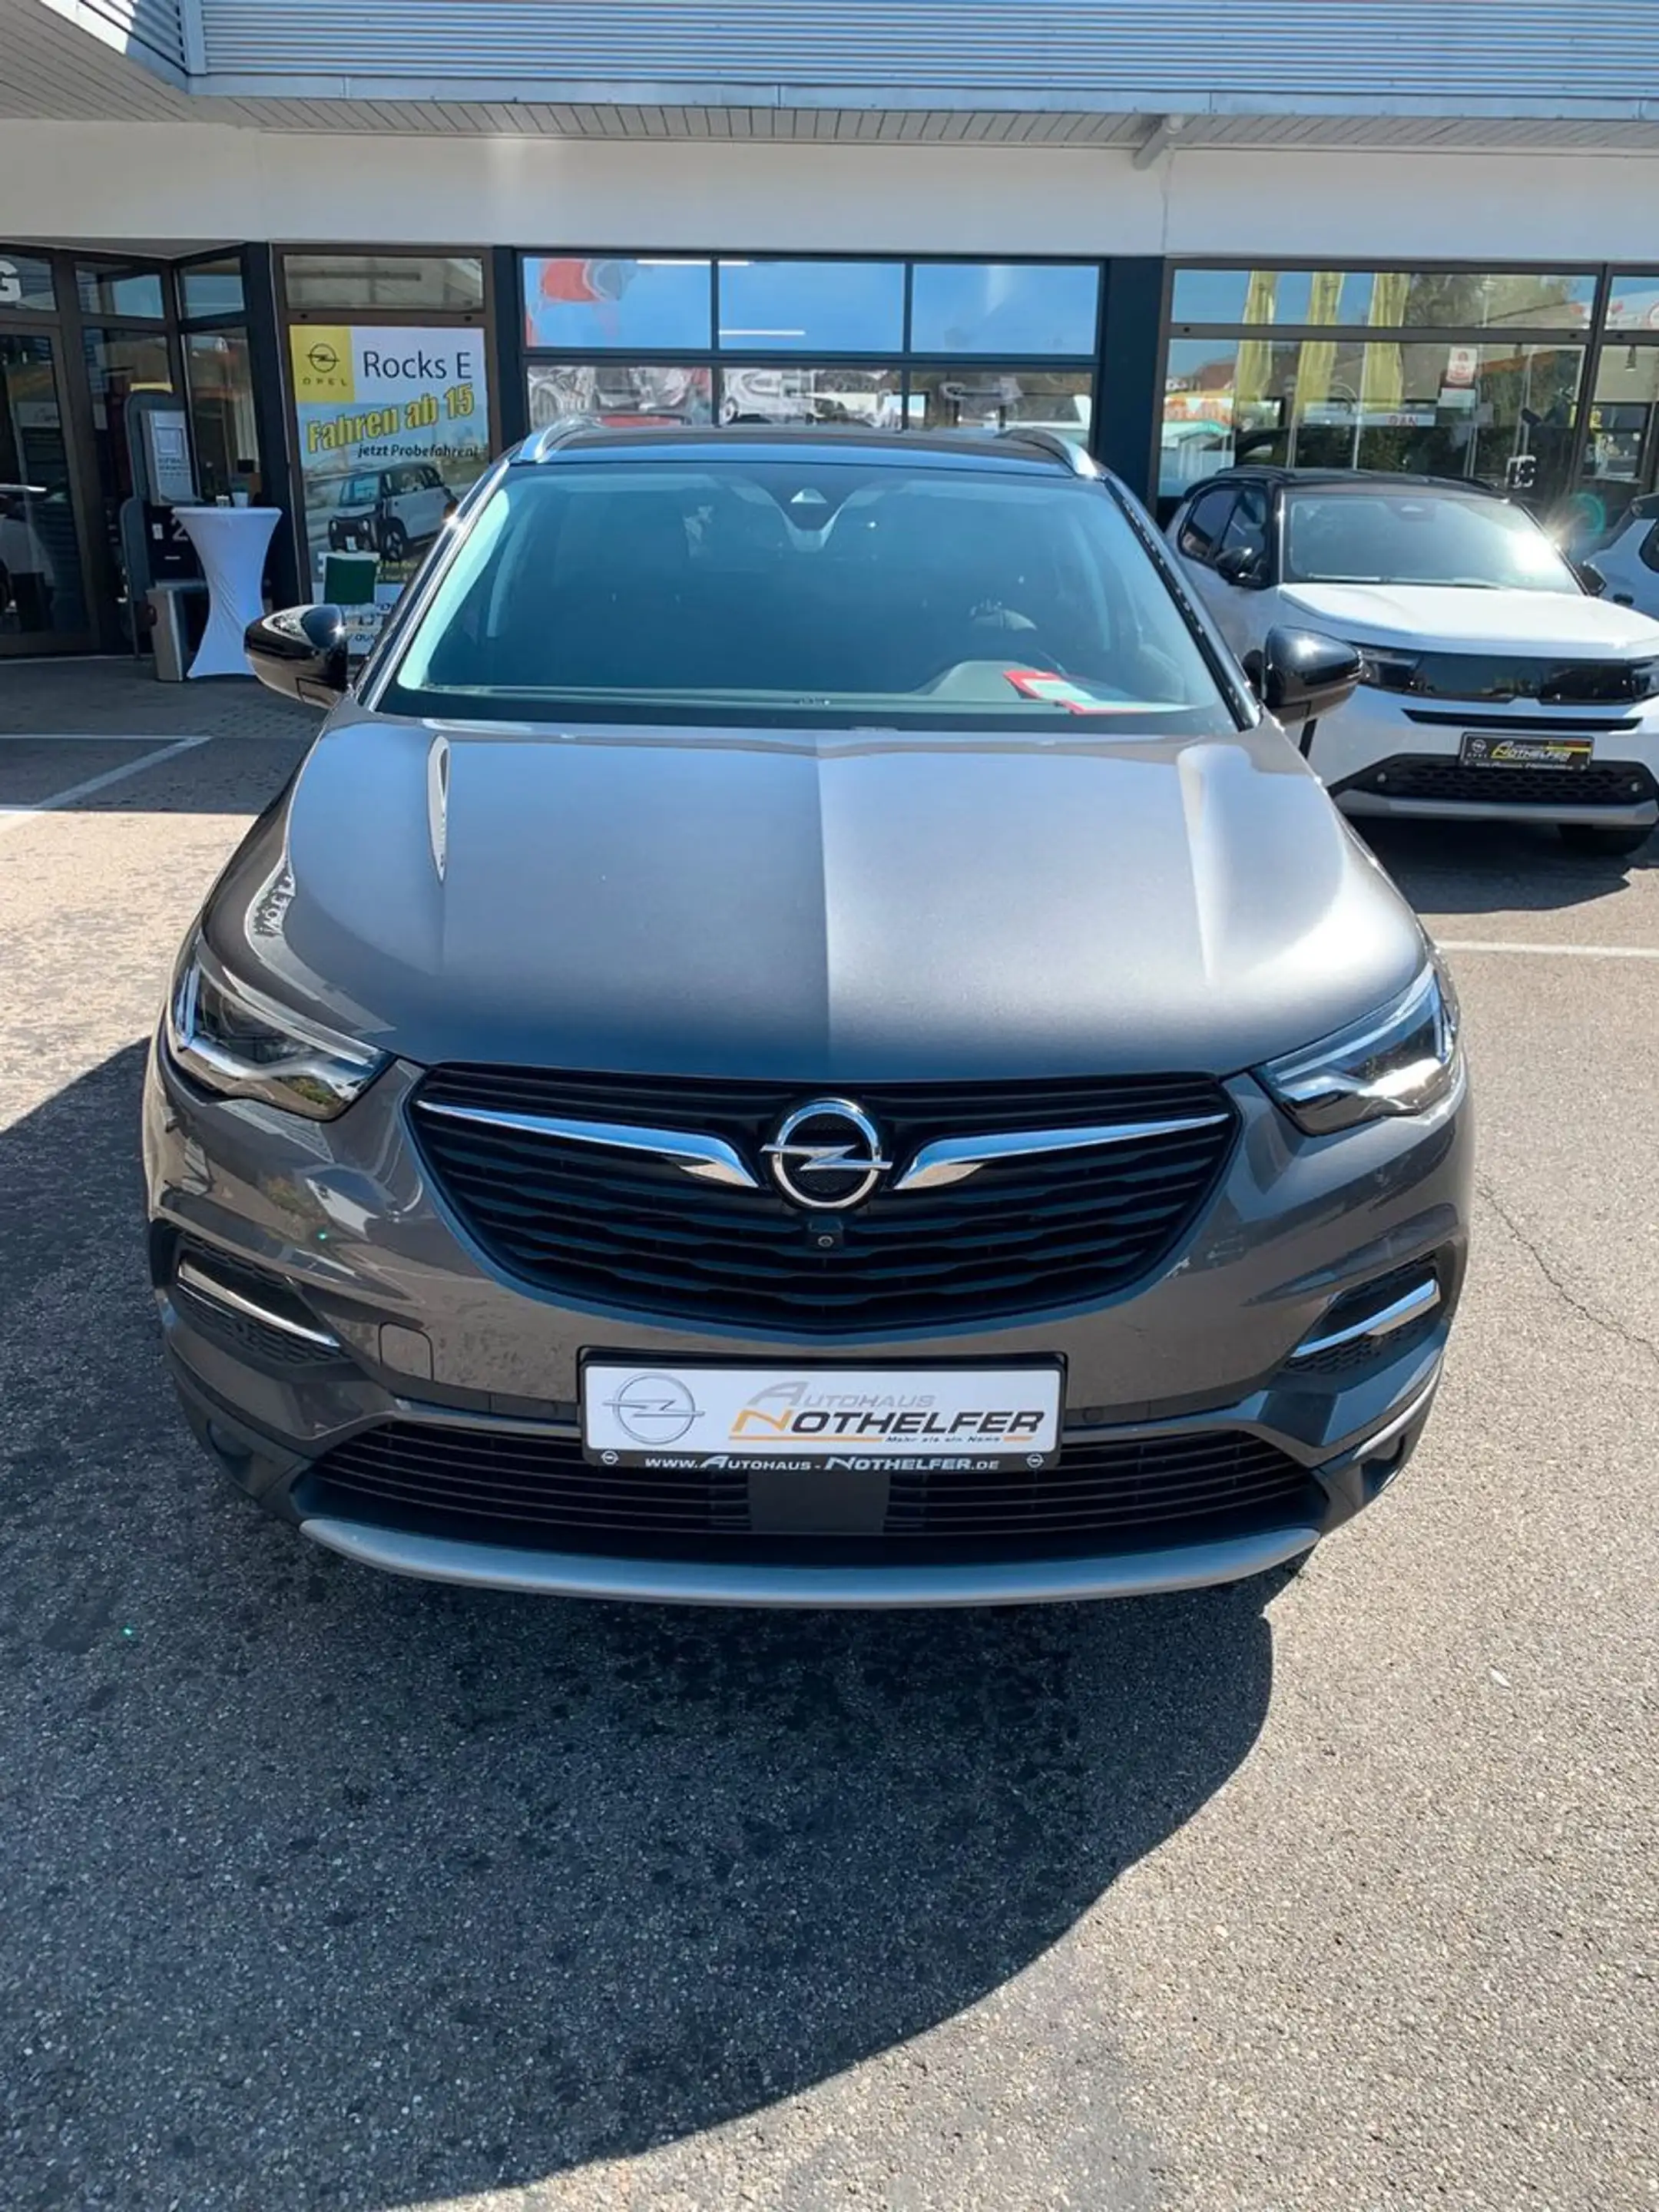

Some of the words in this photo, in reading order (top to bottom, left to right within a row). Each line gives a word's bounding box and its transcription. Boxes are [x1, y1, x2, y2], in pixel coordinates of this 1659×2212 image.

[363, 350, 448, 379] Rocks
[456, 352, 472, 379] E
[302, 376, 347, 386] OPEL
[308, 406, 400, 454] Fahren
[404, 392, 439, 430] ab
[443, 382, 475, 419] 15
[358, 443, 389, 459] jetzt
[747, 1382, 935, 1408] AUTOHAUS
[731, 1409, 1045, 1434] NOTHELFER
